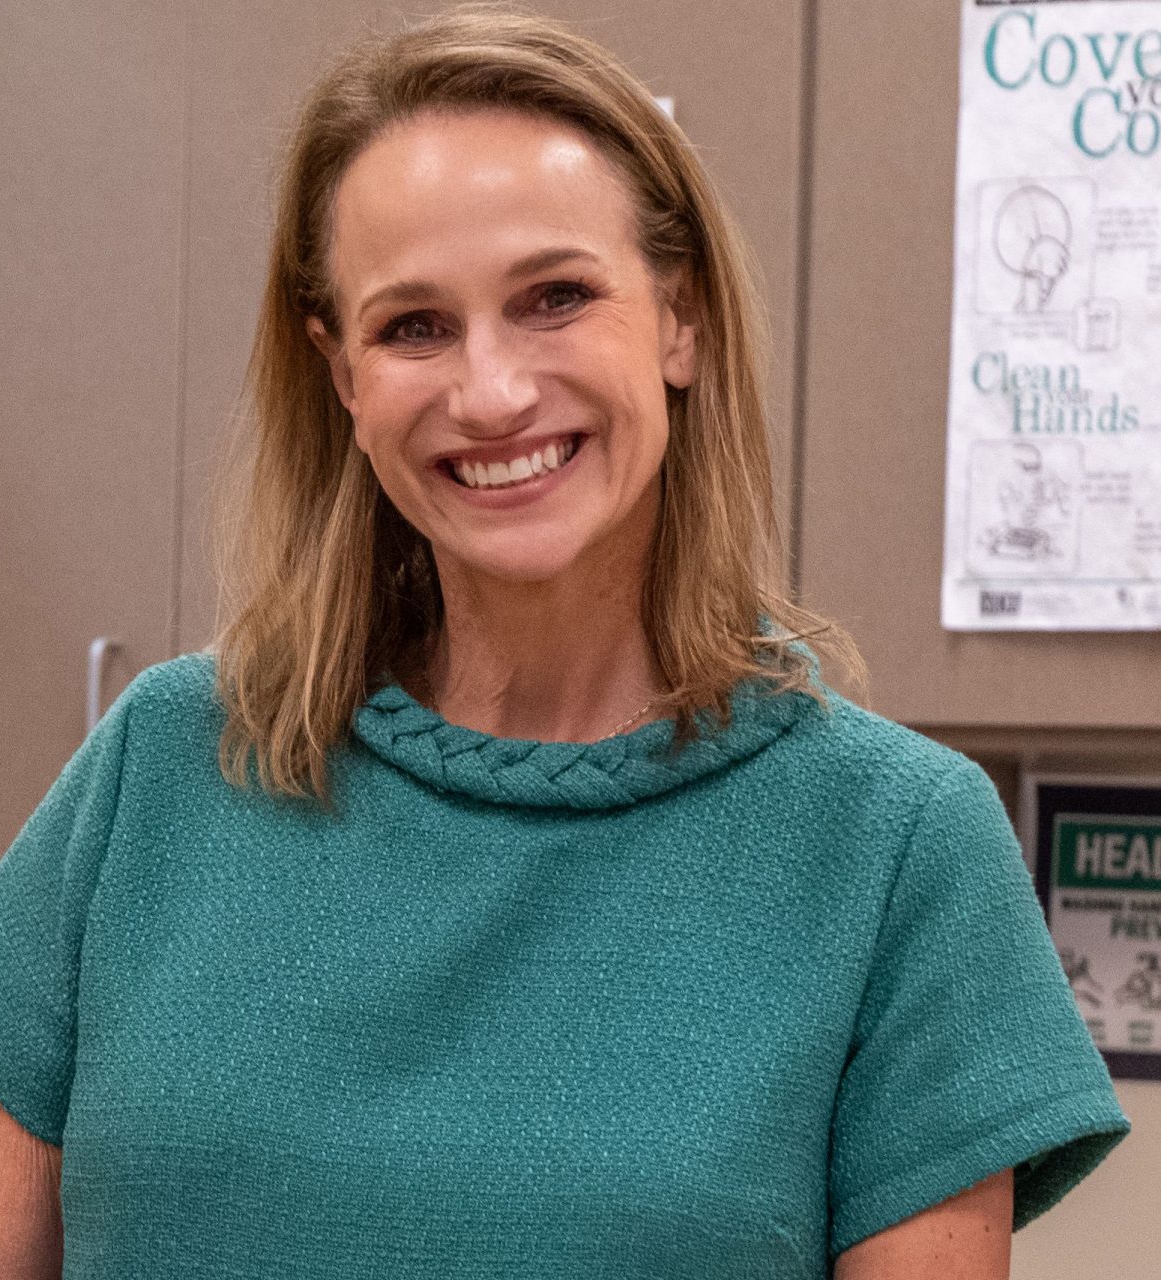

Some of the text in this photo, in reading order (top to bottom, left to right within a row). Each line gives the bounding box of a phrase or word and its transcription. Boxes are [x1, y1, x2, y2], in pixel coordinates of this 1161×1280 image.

[984, 9, 1161, 89] Cove
[1072, 86, 1160, 159] Co
[971, 350, 1080, 394] Clean
[1012, 391, 1139, 433] Hands
